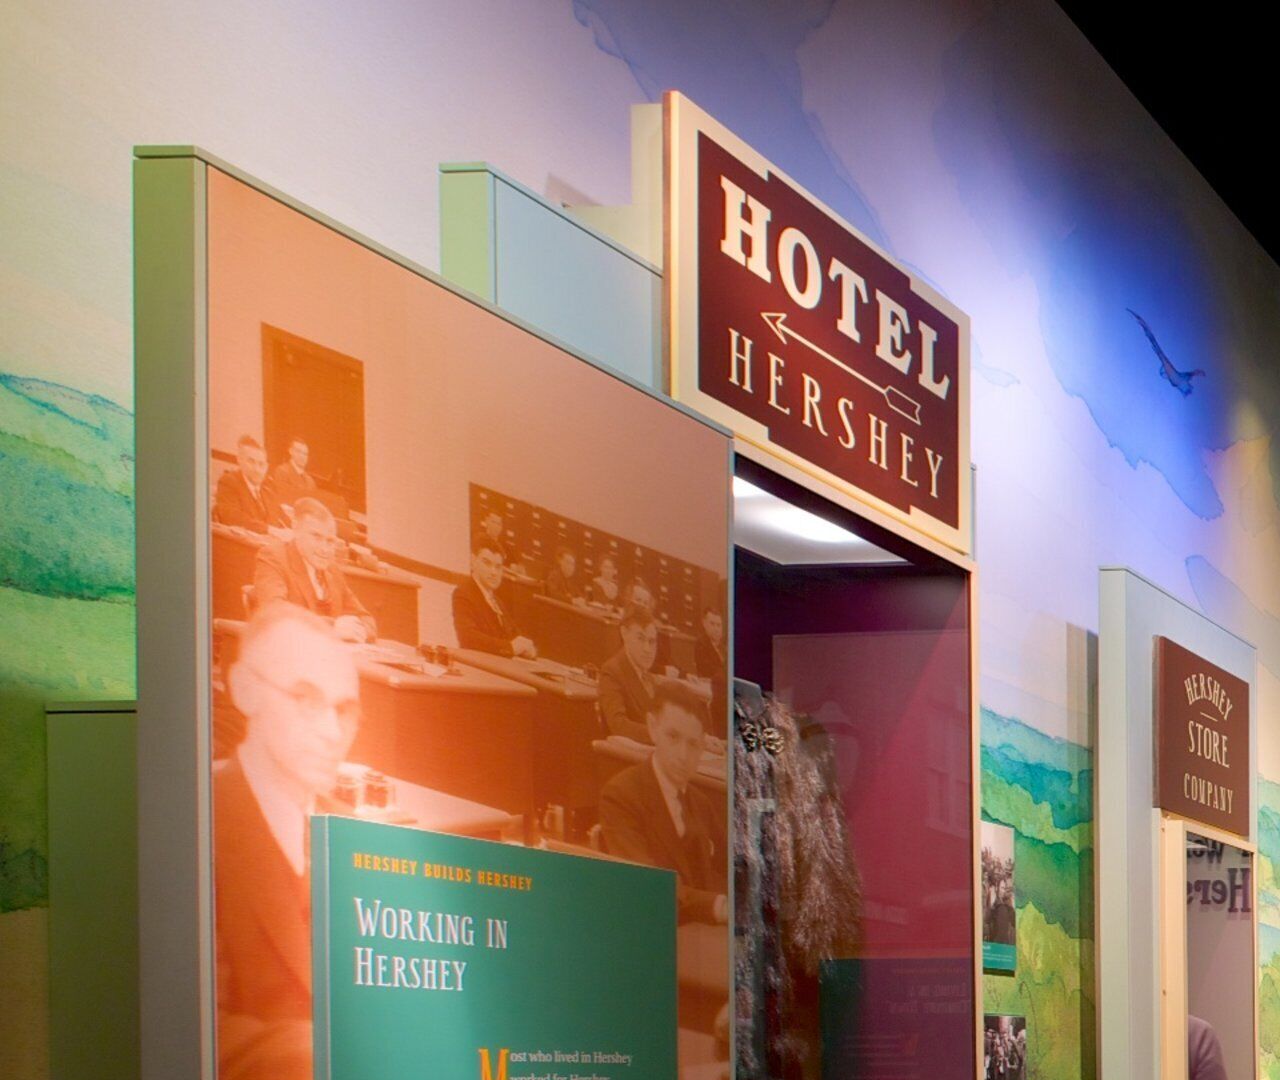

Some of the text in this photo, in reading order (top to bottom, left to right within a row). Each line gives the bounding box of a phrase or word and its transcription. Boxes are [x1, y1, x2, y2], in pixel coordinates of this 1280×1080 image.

[720, 175, 950, 400] HOTEL
[728, 328, 944, 499] HERSHEY
[1184, 673, 1233, 721] HERSHEY
[1188, 720, 1230, 769] STORE
[1184, 772, 1233, 815] COMPANY
[353, 853, 534, 891] HERSHEY BUILDS HERSHEY
[354, 897, 509, 949] WORKING IN
[354, 947, 468, 992] HERSHEY
[529, 1051, 551, 1063] who
[554, 1051, 579, 1063] lived
[581, 1051, 591, 1064] in
[593, 1052, 632, 1067] Hershey
